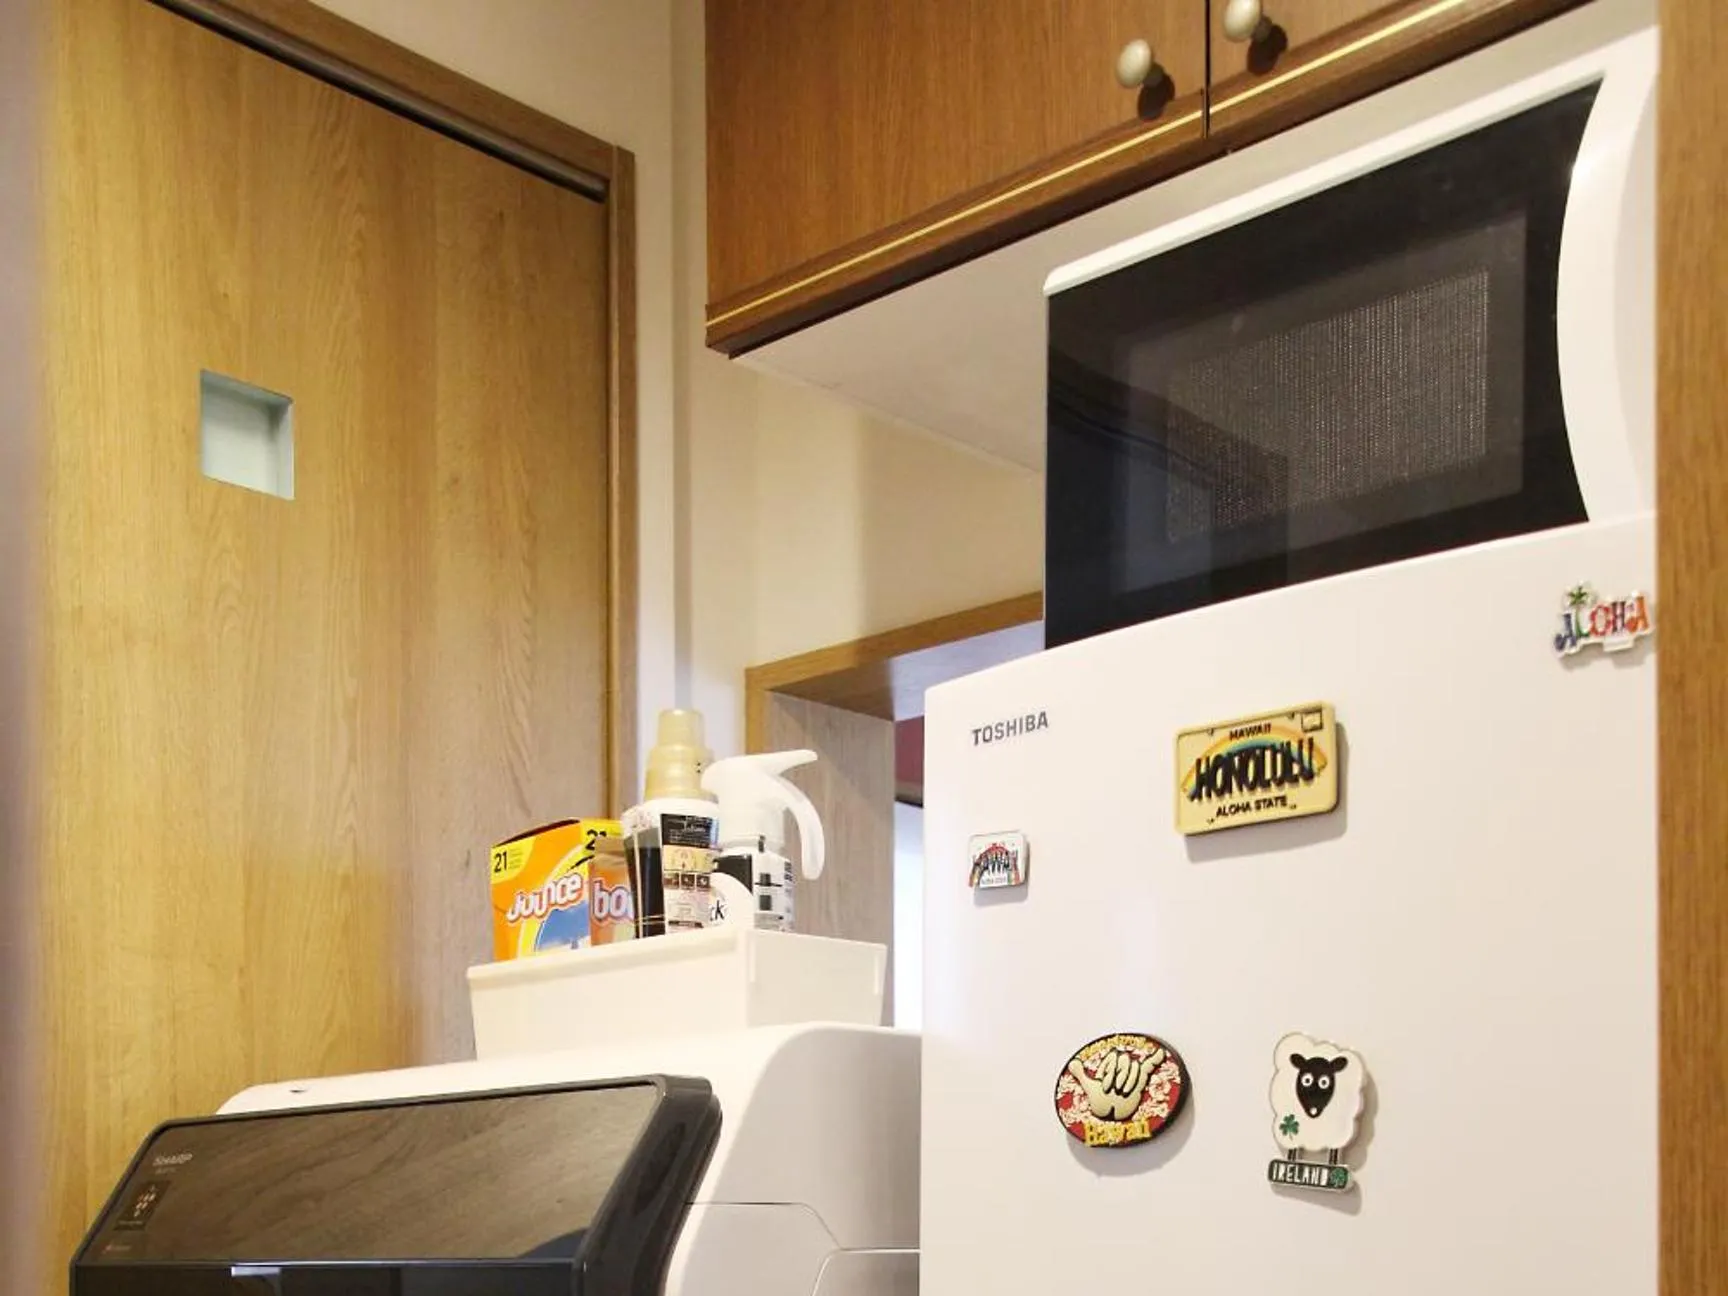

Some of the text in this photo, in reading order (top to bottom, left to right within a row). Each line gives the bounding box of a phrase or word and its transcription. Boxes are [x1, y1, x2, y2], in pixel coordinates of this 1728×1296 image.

[1553, 587, 1650, 652] ALOHA
[972, 711, 1049, 746] TOSHIBA
[1228, 723, 1272, 741] HAWAII
[1187, 737, 1315, 802] HONOLULU
[1215, 795, 1288, 818] ALOHA STATE
[494, 851, 508, 873] 21
[1272, 1162, 1329, 1186] IRELAND
